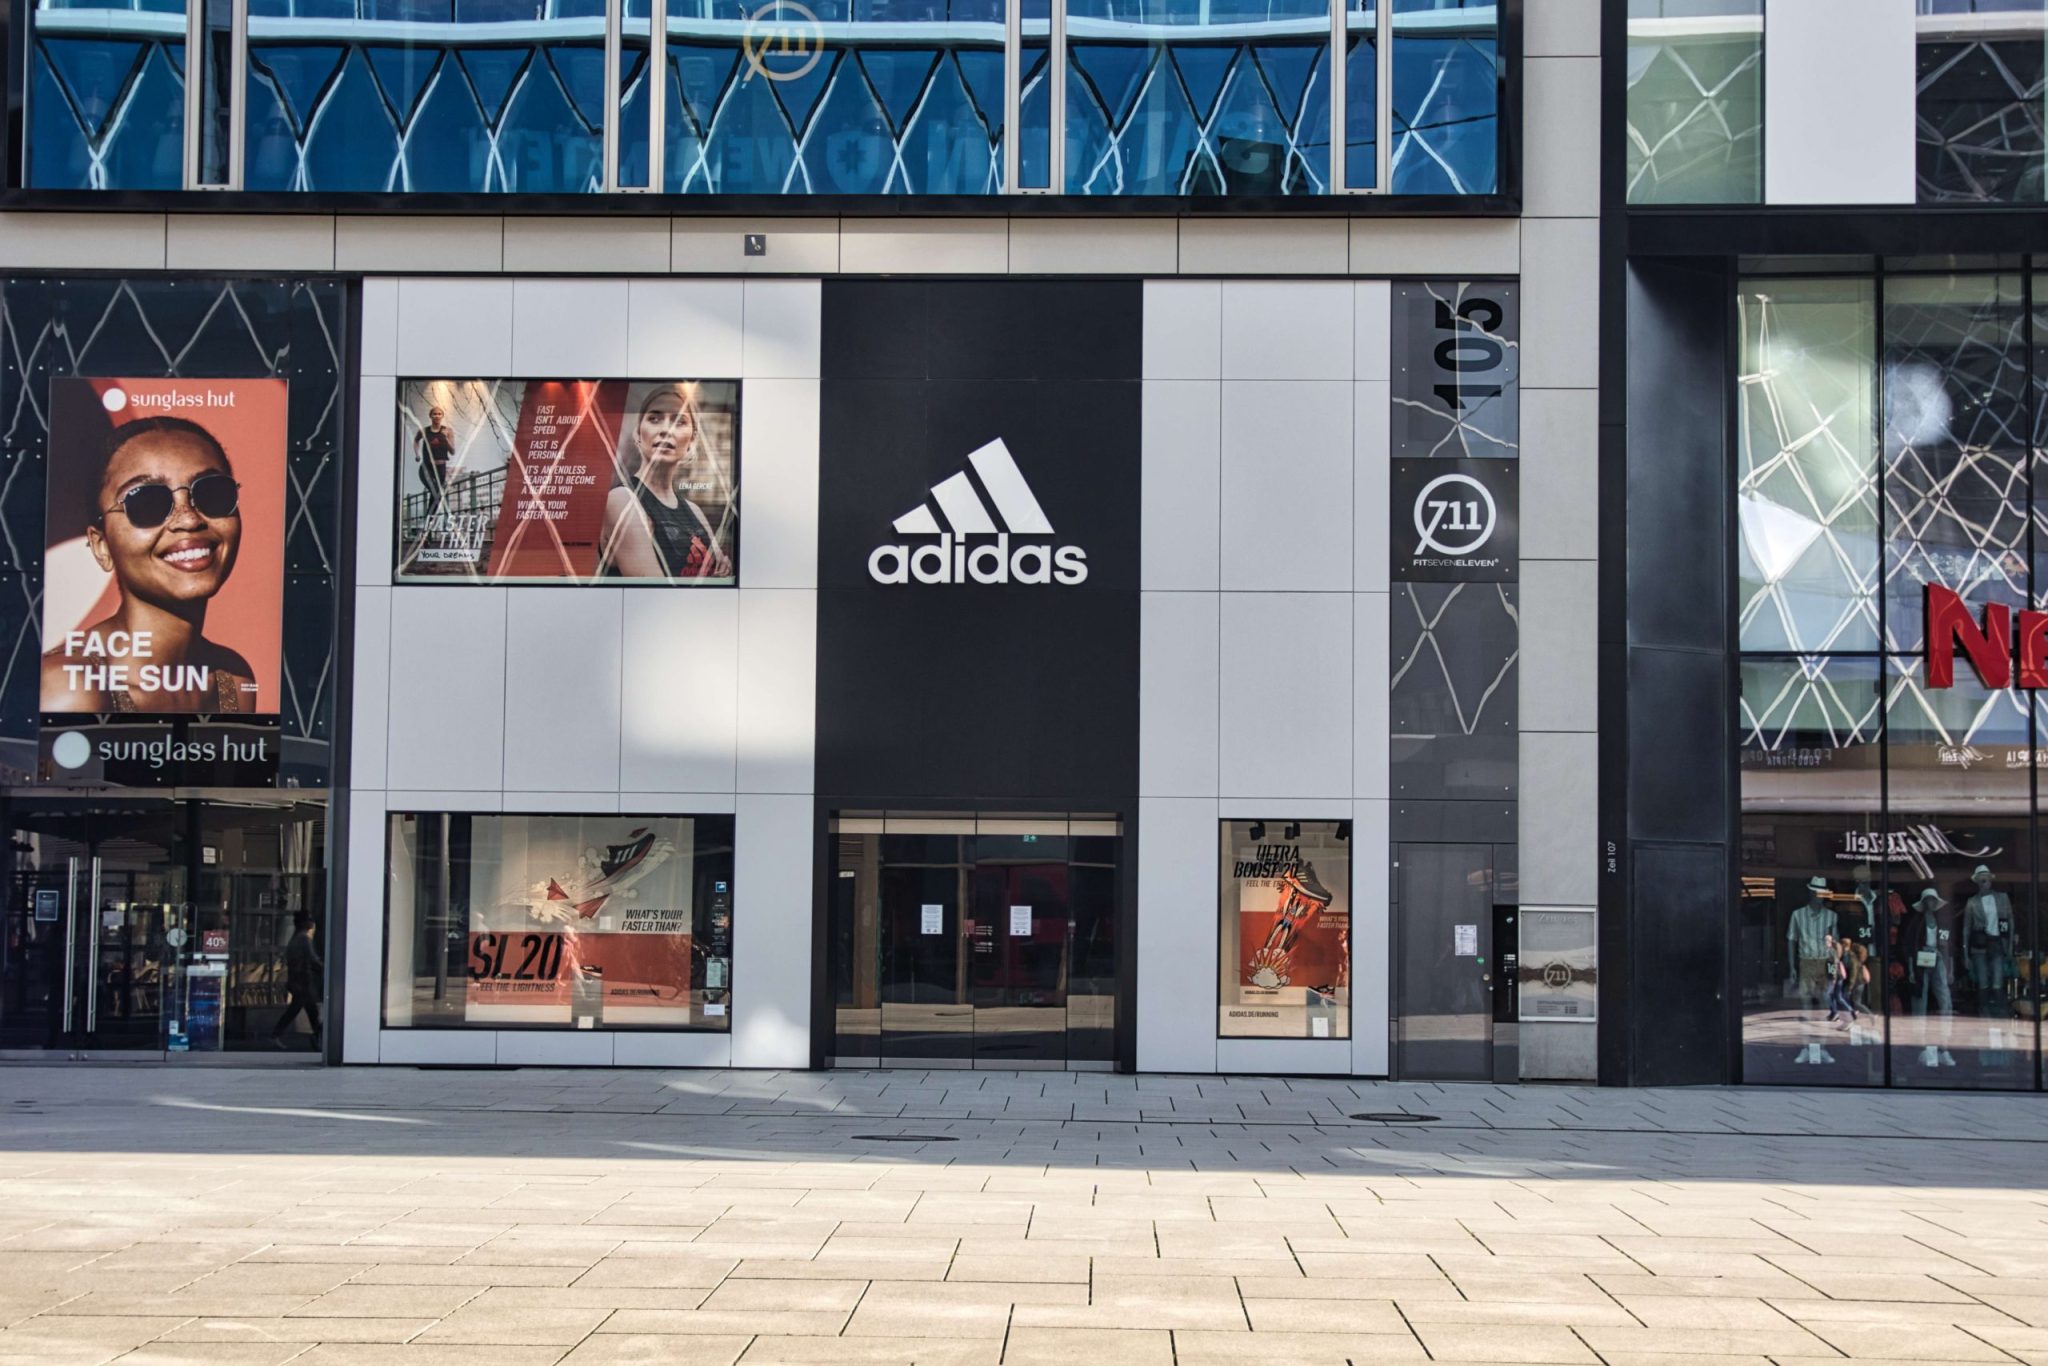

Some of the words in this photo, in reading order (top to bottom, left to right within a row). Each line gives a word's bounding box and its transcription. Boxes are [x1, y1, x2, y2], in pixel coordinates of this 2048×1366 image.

[1434, 298, 1503, 409] 105
[131, 389, 204, 411] sunglass
[207, 390, 235, 407] hut
[537, 405, 555, 415] FAST
[535, 415, 554, 425] ISN'T
[556, 415, 582, 425] ABOUT
[533, 425, 556, 435] SPEED
[530, 440, 548, 450] FAST
[550, 440, 559, 450] IS
[528, 450, 565, 460] PERSONAL
[525, 465, 539, 475] IT'S
[554, 465, 587, 475] ENDLESS
[554, 475, 564, 485] TO
[565, 475, 596, 485] BECOME
[521, 485, 527, 495] A
[558, 485, 573, 495] YOU
[548, 500, 566, 510] YOUR
[516, 510, 543, 520] FASTER
[424, 514, 490, 532] FASTER
[440, 532, 485, 549] THAN
[421, 551, 440, 559] YOUR
[868, 533, 1088, 585] adidas
[65, 631, 153, 657] FACE
[63, 665, 129, 692] THE
[139, 665, 209, 692] SUN
[99, 734, 216, 768] sunglass
[222, 735, 268, 762] hut
[1256, 845, 1299, 861] ULTRA
[1608, 841, 1616, 856] 107
[1233, 862, 1278, 878] BOOST
[1608, 858, 1616, 873] Zeil
[626, 909, 658, 920] WHAT'S
[660, 909, 683, 920] YOUR
[622, 920, 653, 931] FASTER
[655, 921, 682, 932] THAN?
[495, 982, 510, 992] THE
[512, 983, 556, 992] LIGHTNESS
